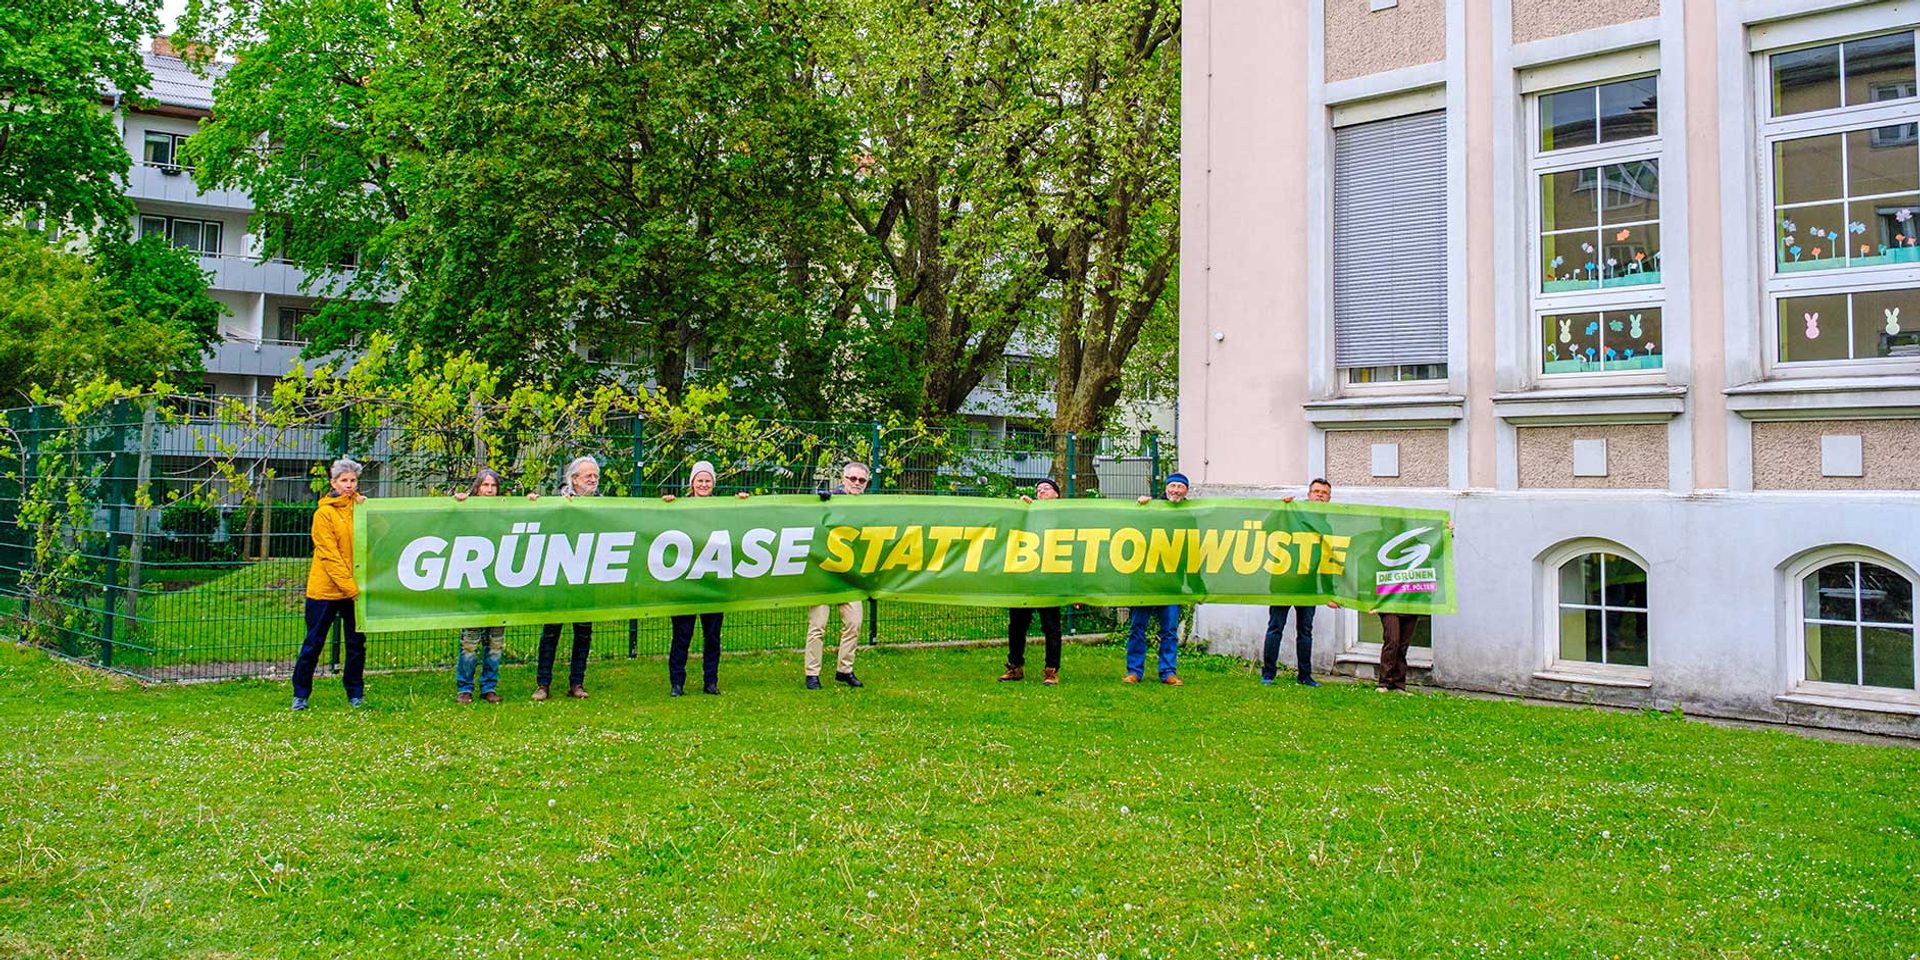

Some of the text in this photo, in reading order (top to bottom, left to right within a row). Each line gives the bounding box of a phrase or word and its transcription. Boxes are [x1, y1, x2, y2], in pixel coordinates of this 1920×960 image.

[397, 520, 1352, 591] GRÜNE OASE STATT BETONWÜSTE
[1379, 570, 1434, 582] DIE GRÜNEN
